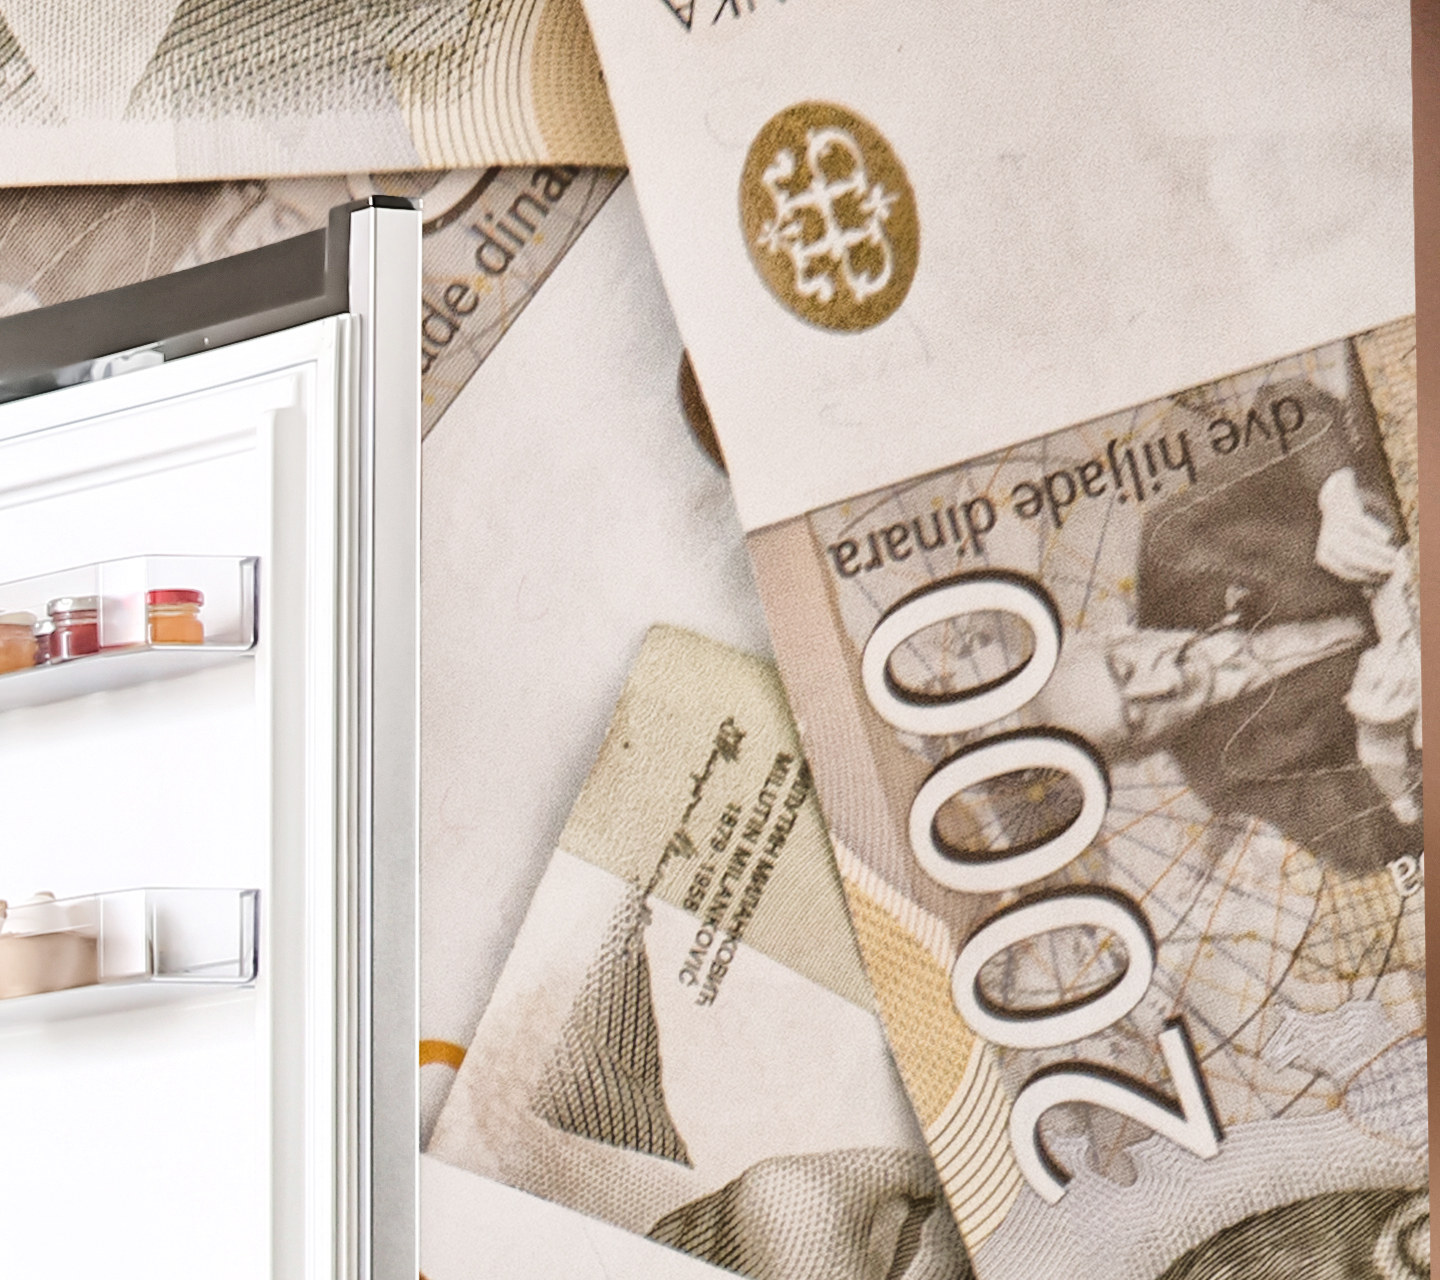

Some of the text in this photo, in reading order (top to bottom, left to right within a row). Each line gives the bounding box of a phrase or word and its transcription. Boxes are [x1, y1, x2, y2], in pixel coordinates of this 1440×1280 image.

[827, 395, 1307, 581] dve hiljade dinara
[862, 567, 1226, 1205] 2000
